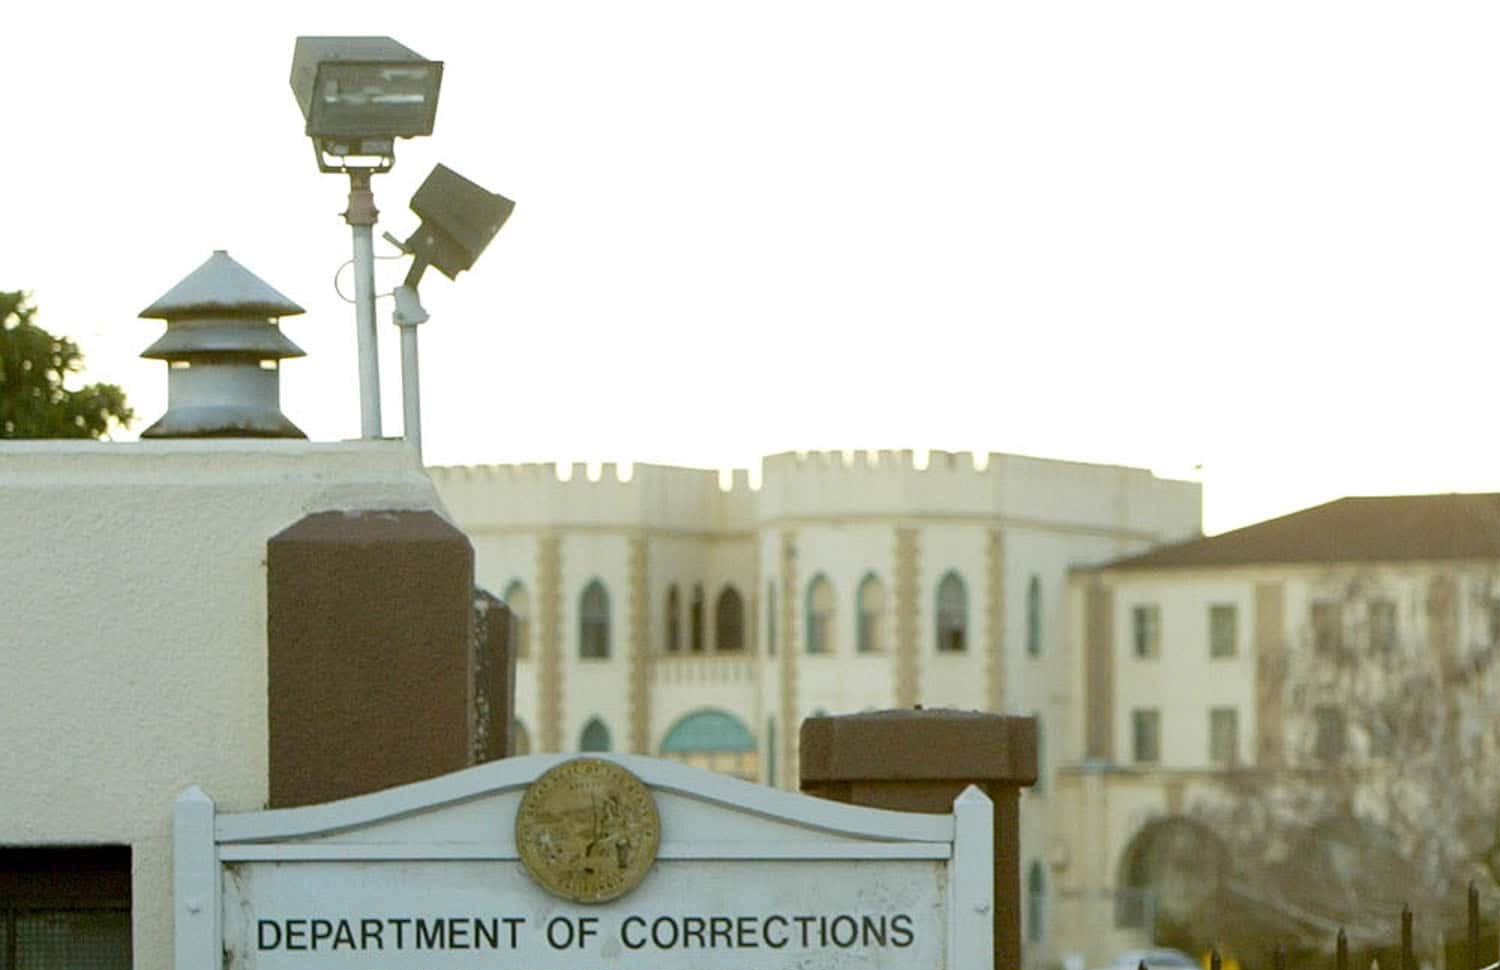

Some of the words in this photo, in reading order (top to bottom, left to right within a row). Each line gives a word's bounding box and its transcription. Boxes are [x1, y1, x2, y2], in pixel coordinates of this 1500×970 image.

[258, 918, 526, 950] DEPARTMENT
[547, 917, 599, 950] OF
[621, 915, 914, 949] CORRECTIONS
